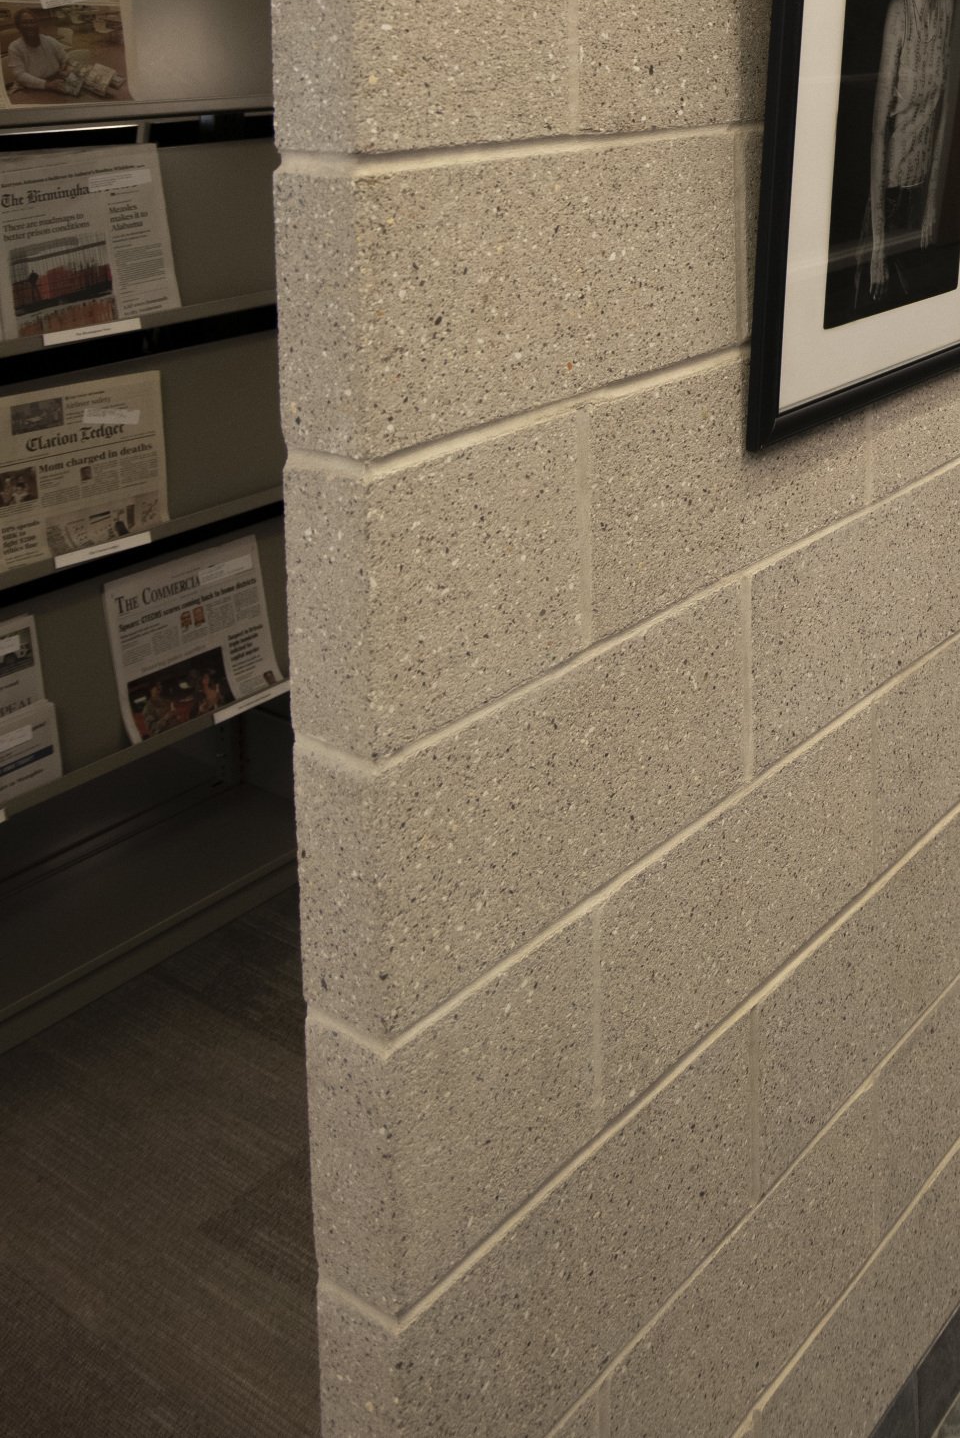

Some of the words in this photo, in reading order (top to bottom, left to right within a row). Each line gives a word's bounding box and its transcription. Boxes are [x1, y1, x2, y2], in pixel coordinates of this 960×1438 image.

[0, 194, 24, 208] The
[27, 184, 92, 204] Birmingha
[26, 432, 77, 452] Clarion
[80, 424, 125, 442] Ledger
[39, 462, 64, 474] Mom
[66, 452, 106, 468] charged
[108, 449, 118, 458] in
[120, 442, 153, 457] deaths
[142, 575, 200, 606] COMMERCIA
